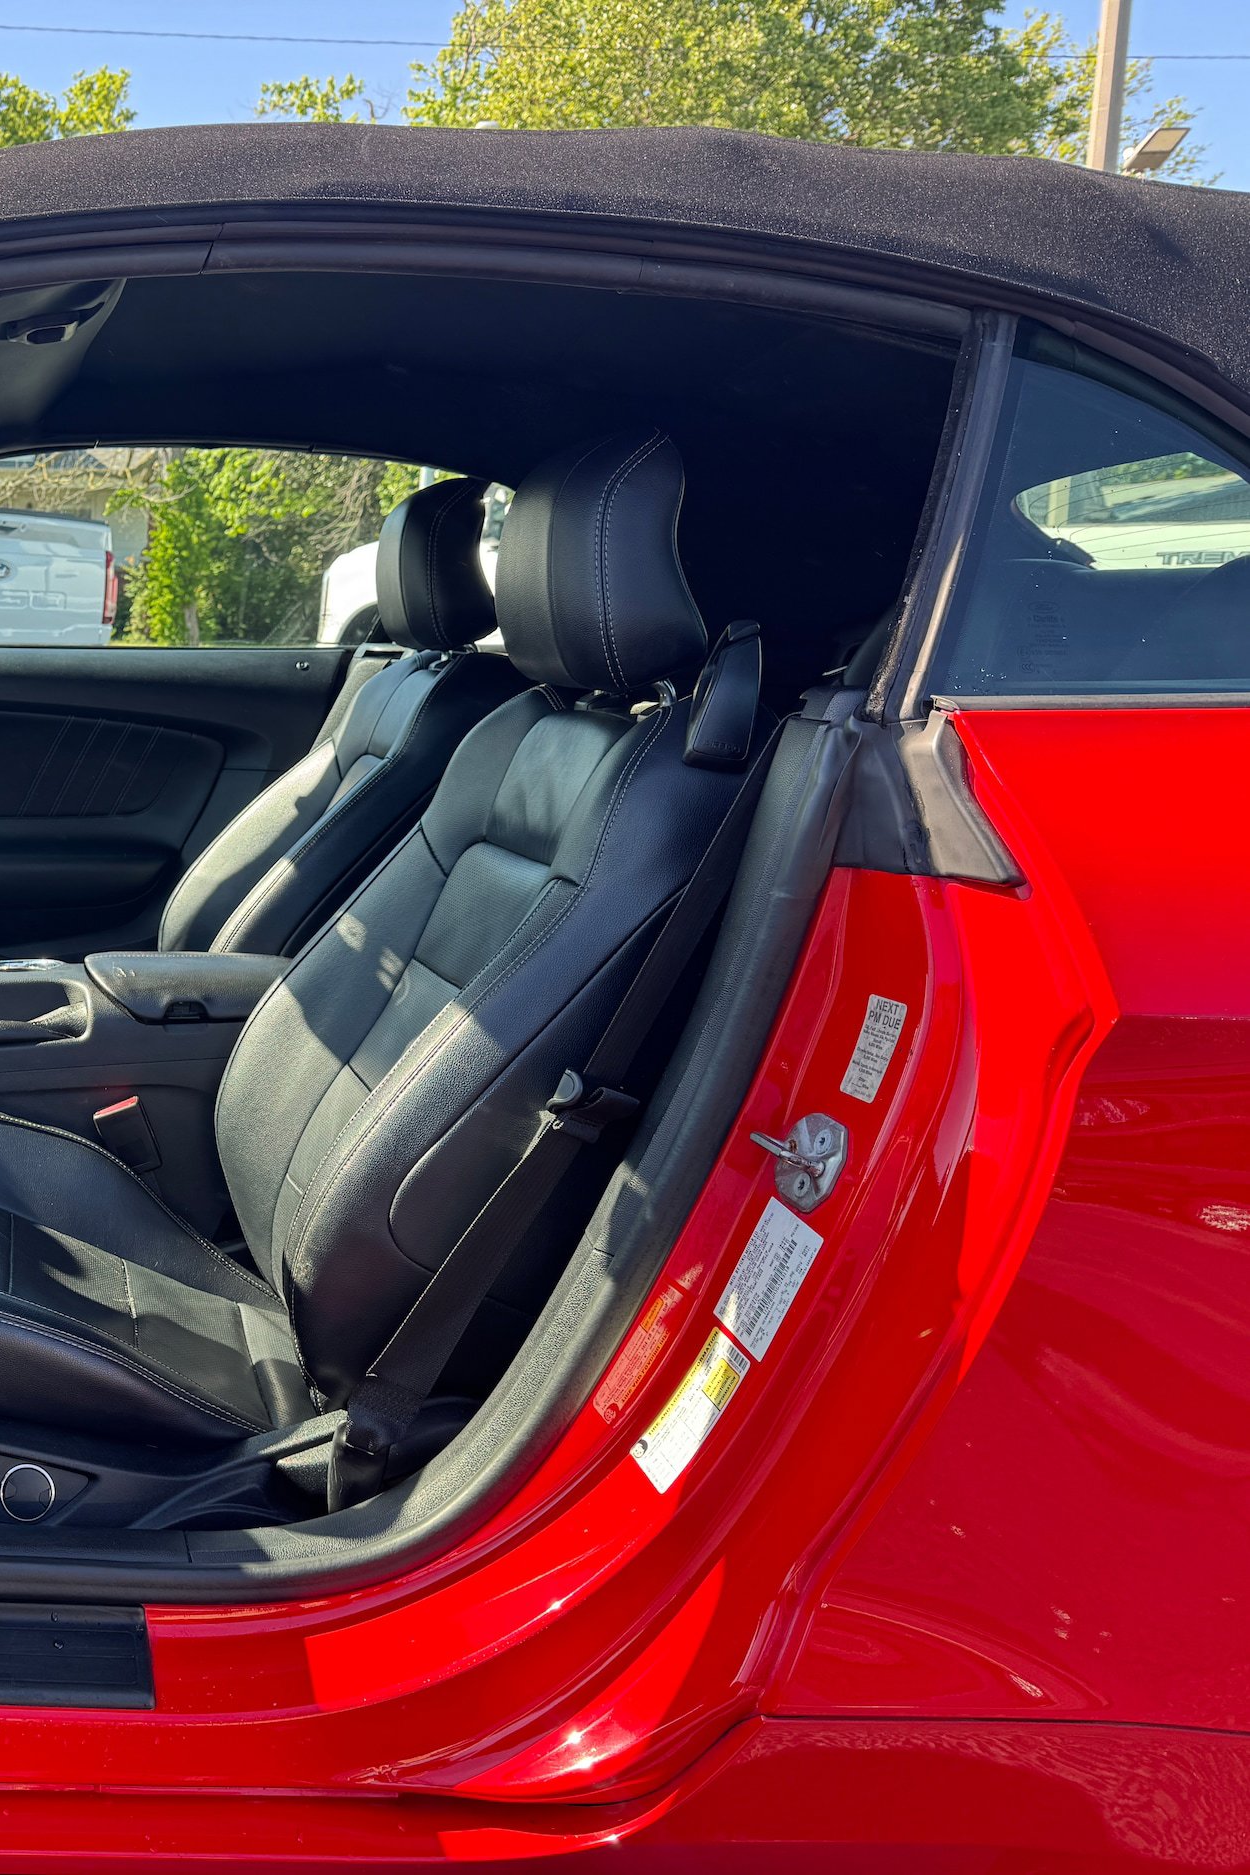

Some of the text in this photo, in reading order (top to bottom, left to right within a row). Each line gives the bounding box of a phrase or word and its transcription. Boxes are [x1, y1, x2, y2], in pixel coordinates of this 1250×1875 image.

[876, 999, 899, 1015] NEXT
[868, 1010, 901, 1029] PM DUE
